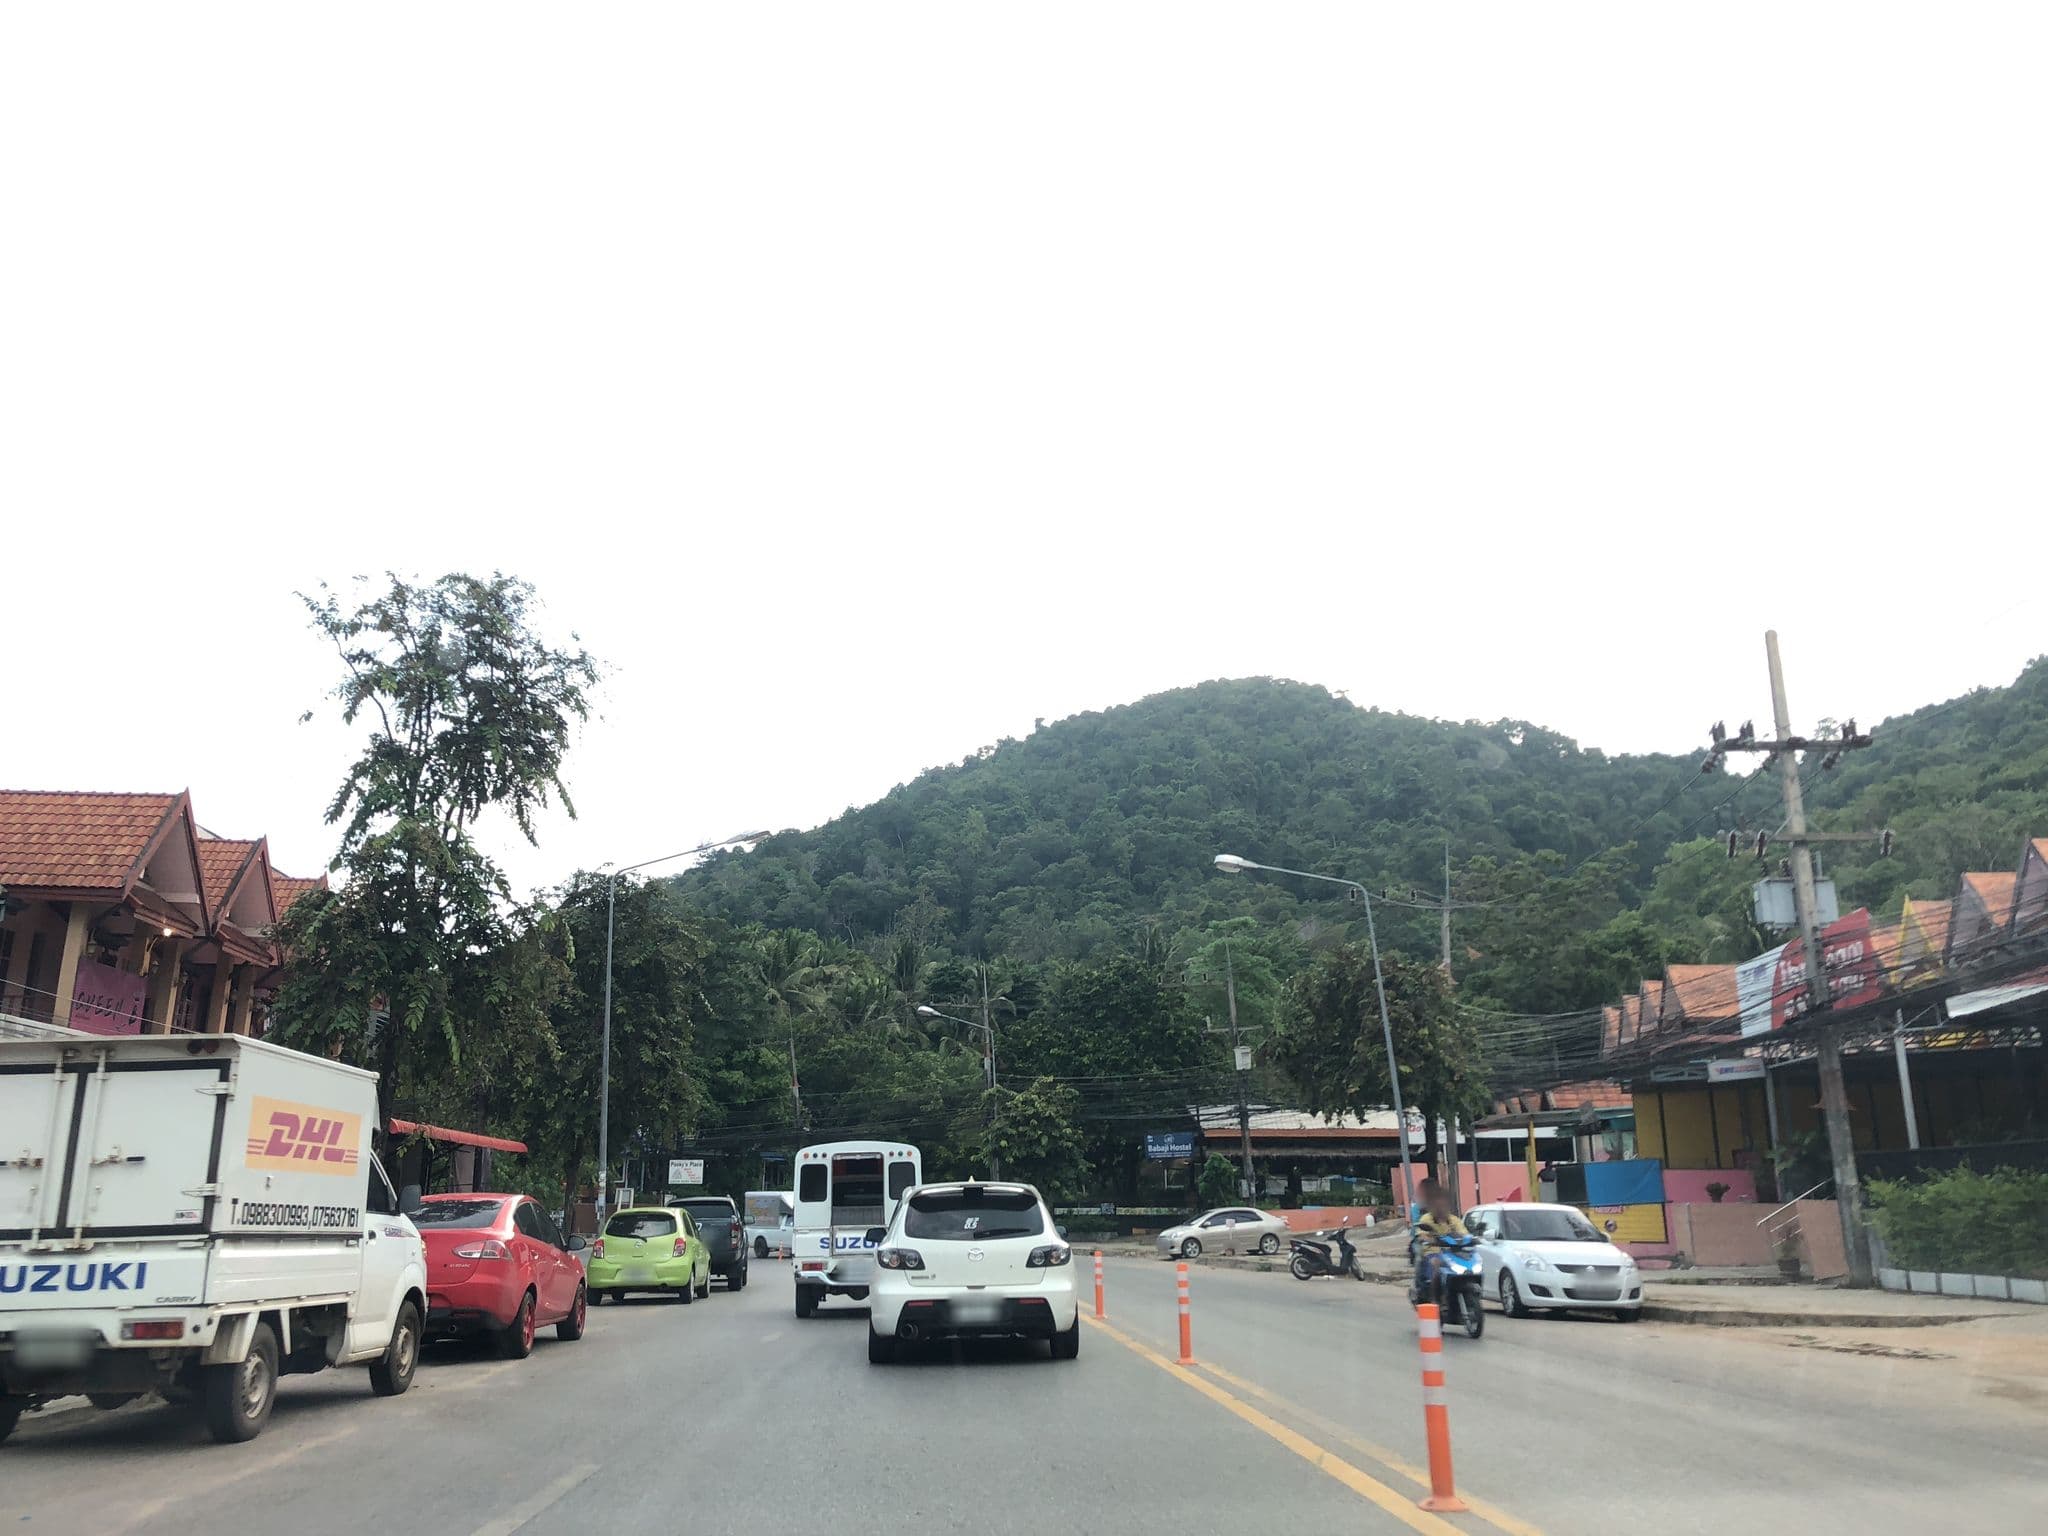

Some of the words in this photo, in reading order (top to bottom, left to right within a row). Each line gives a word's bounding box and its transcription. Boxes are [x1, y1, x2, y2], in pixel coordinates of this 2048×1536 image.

[264, 1111, 344, 1162] DHL
[819, 1237, 880, 1249] SUZU
[155, 1296, 197, 1304] CARRY
